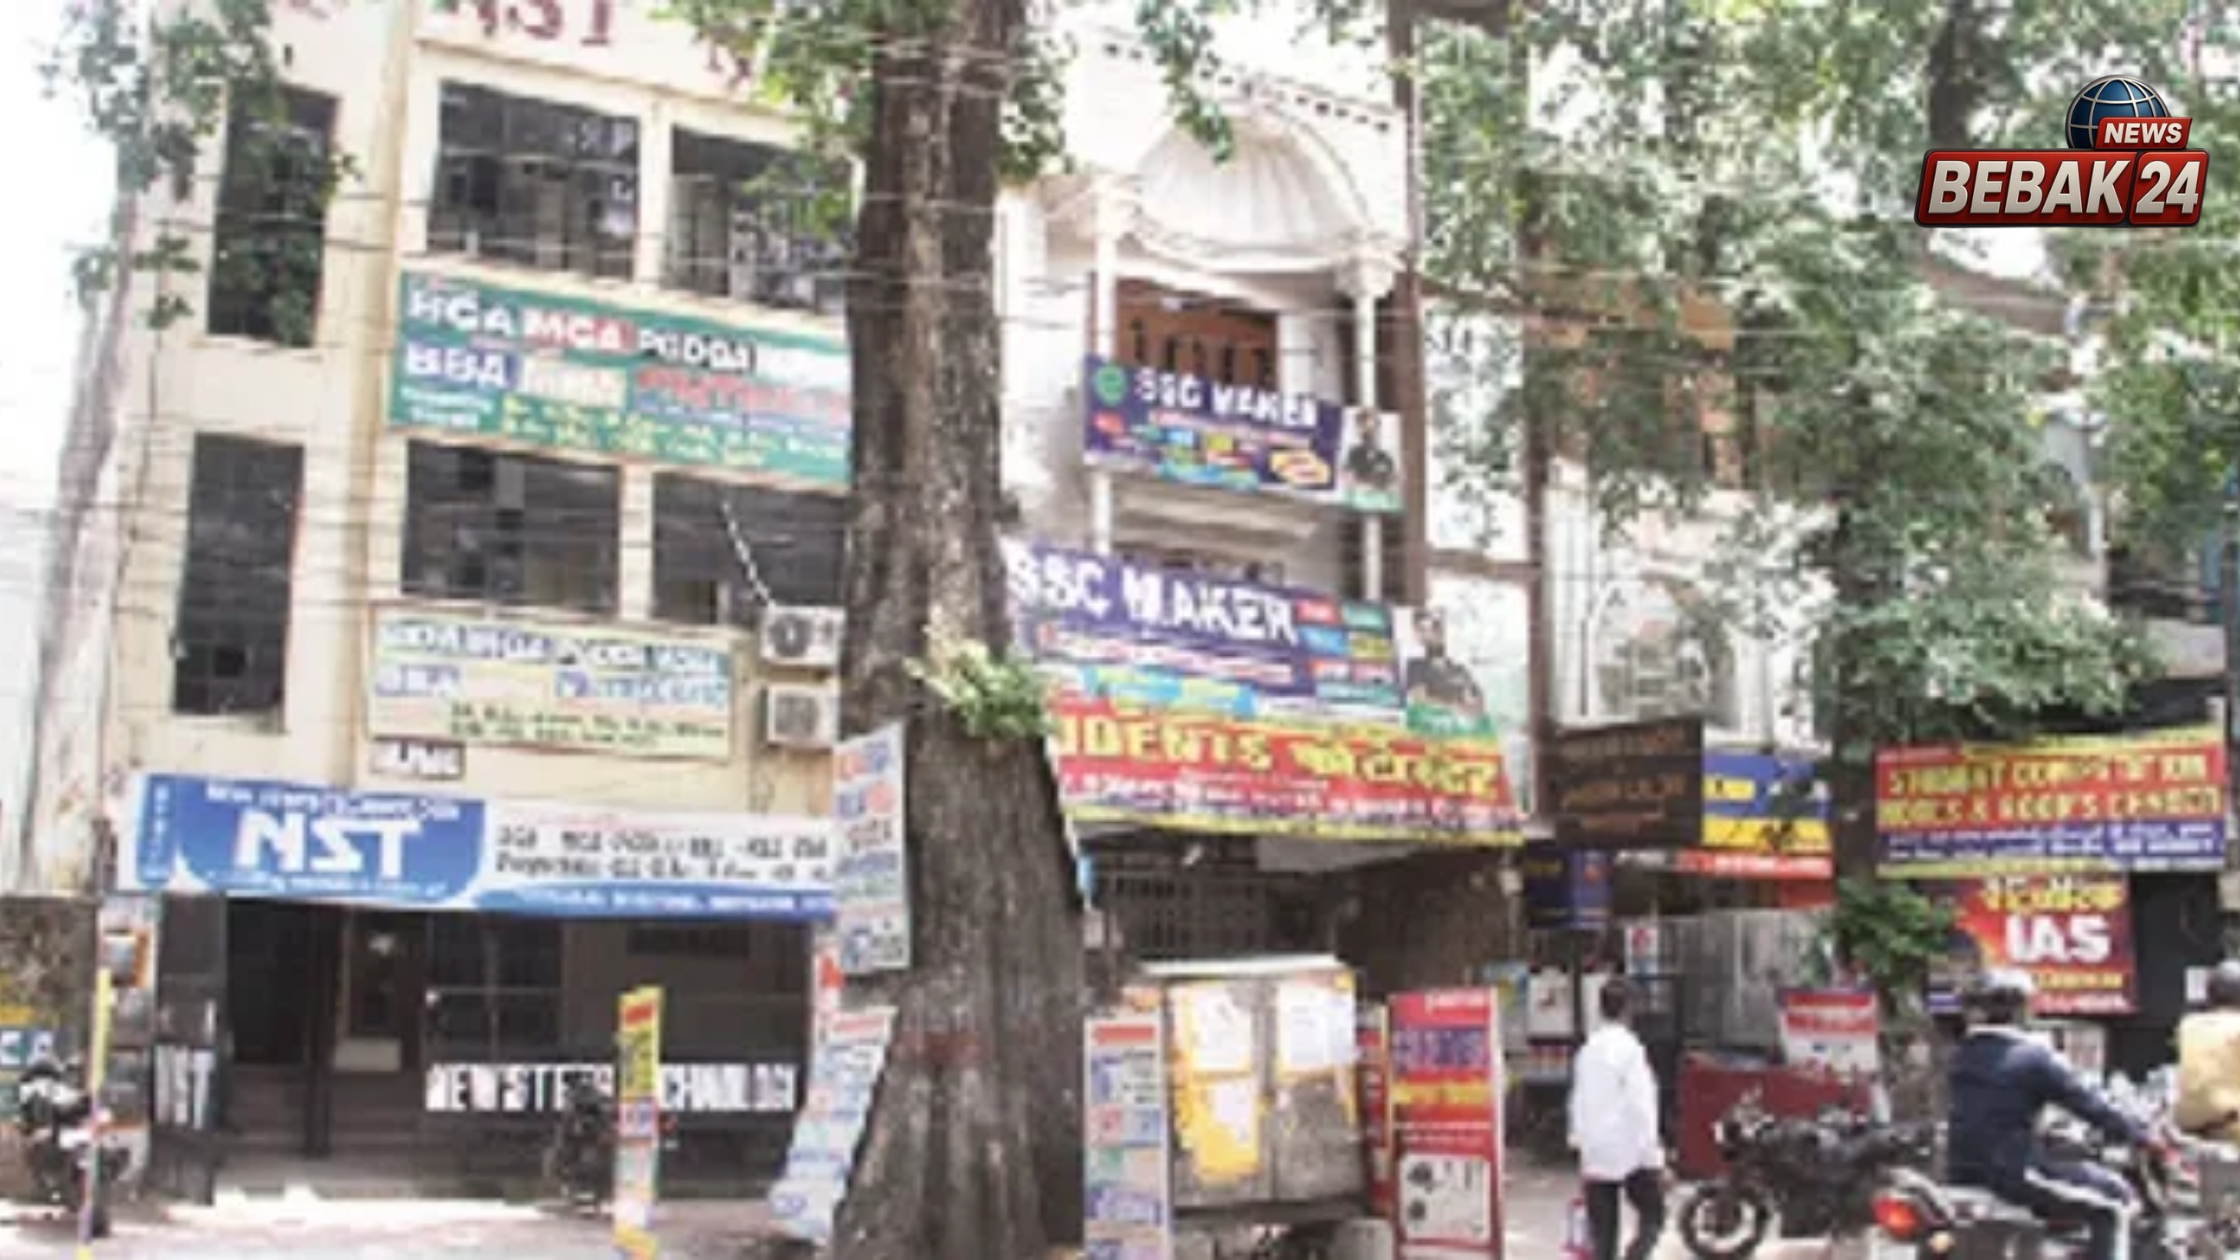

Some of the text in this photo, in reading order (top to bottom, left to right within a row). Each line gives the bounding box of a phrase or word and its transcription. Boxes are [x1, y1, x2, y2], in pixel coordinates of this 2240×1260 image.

[1123, 565, 1298, 646] MAKER
[234, 806, 422, 884] NST
[2005, 914, 2112, 964] IAS
